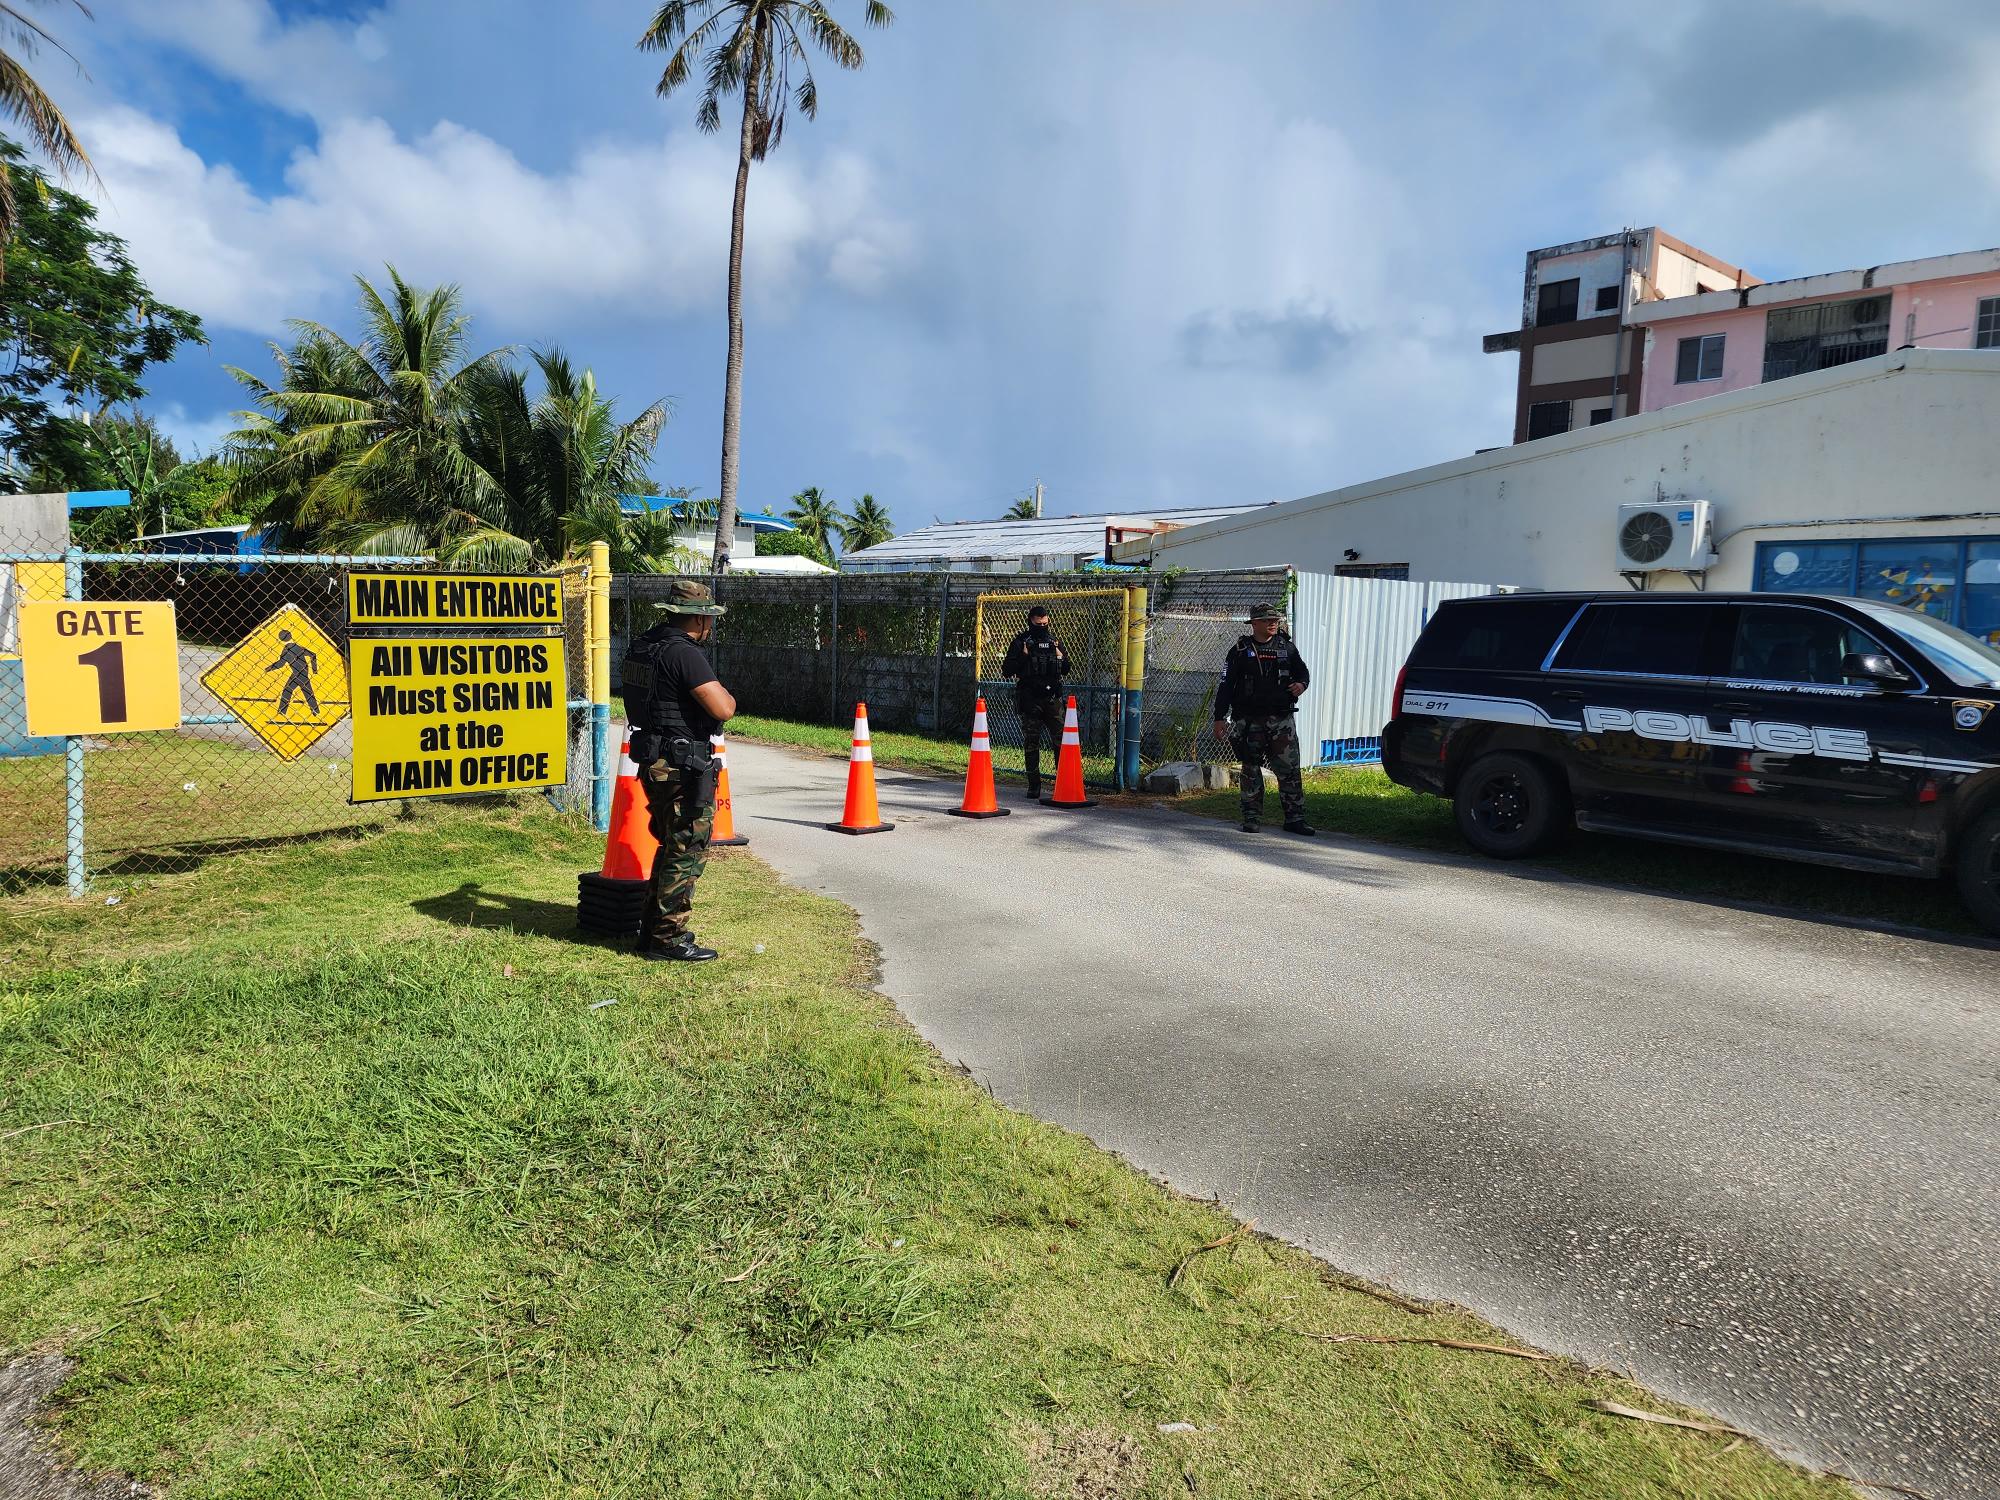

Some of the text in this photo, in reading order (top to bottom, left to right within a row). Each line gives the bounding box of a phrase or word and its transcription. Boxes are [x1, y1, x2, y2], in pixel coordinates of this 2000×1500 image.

[356, 578, 558, 618] MAIN ENTRANCE
[56, 610, 144, 637] GATE
[371, 644, 548, 677] All VISITORS
[78, 641, 127, 723] 1
[369, 681, 552, 716] Must SIGN IN
[1726, 682, 1864, 698] NORTHERN MARIANAS
[1425, 701, 1449, 711] 911
[420, 720, 504, 752] at the
[1583, 705, 1872, 762] POLICE
[375, 752, 549, 792] MAIN OFFICE
